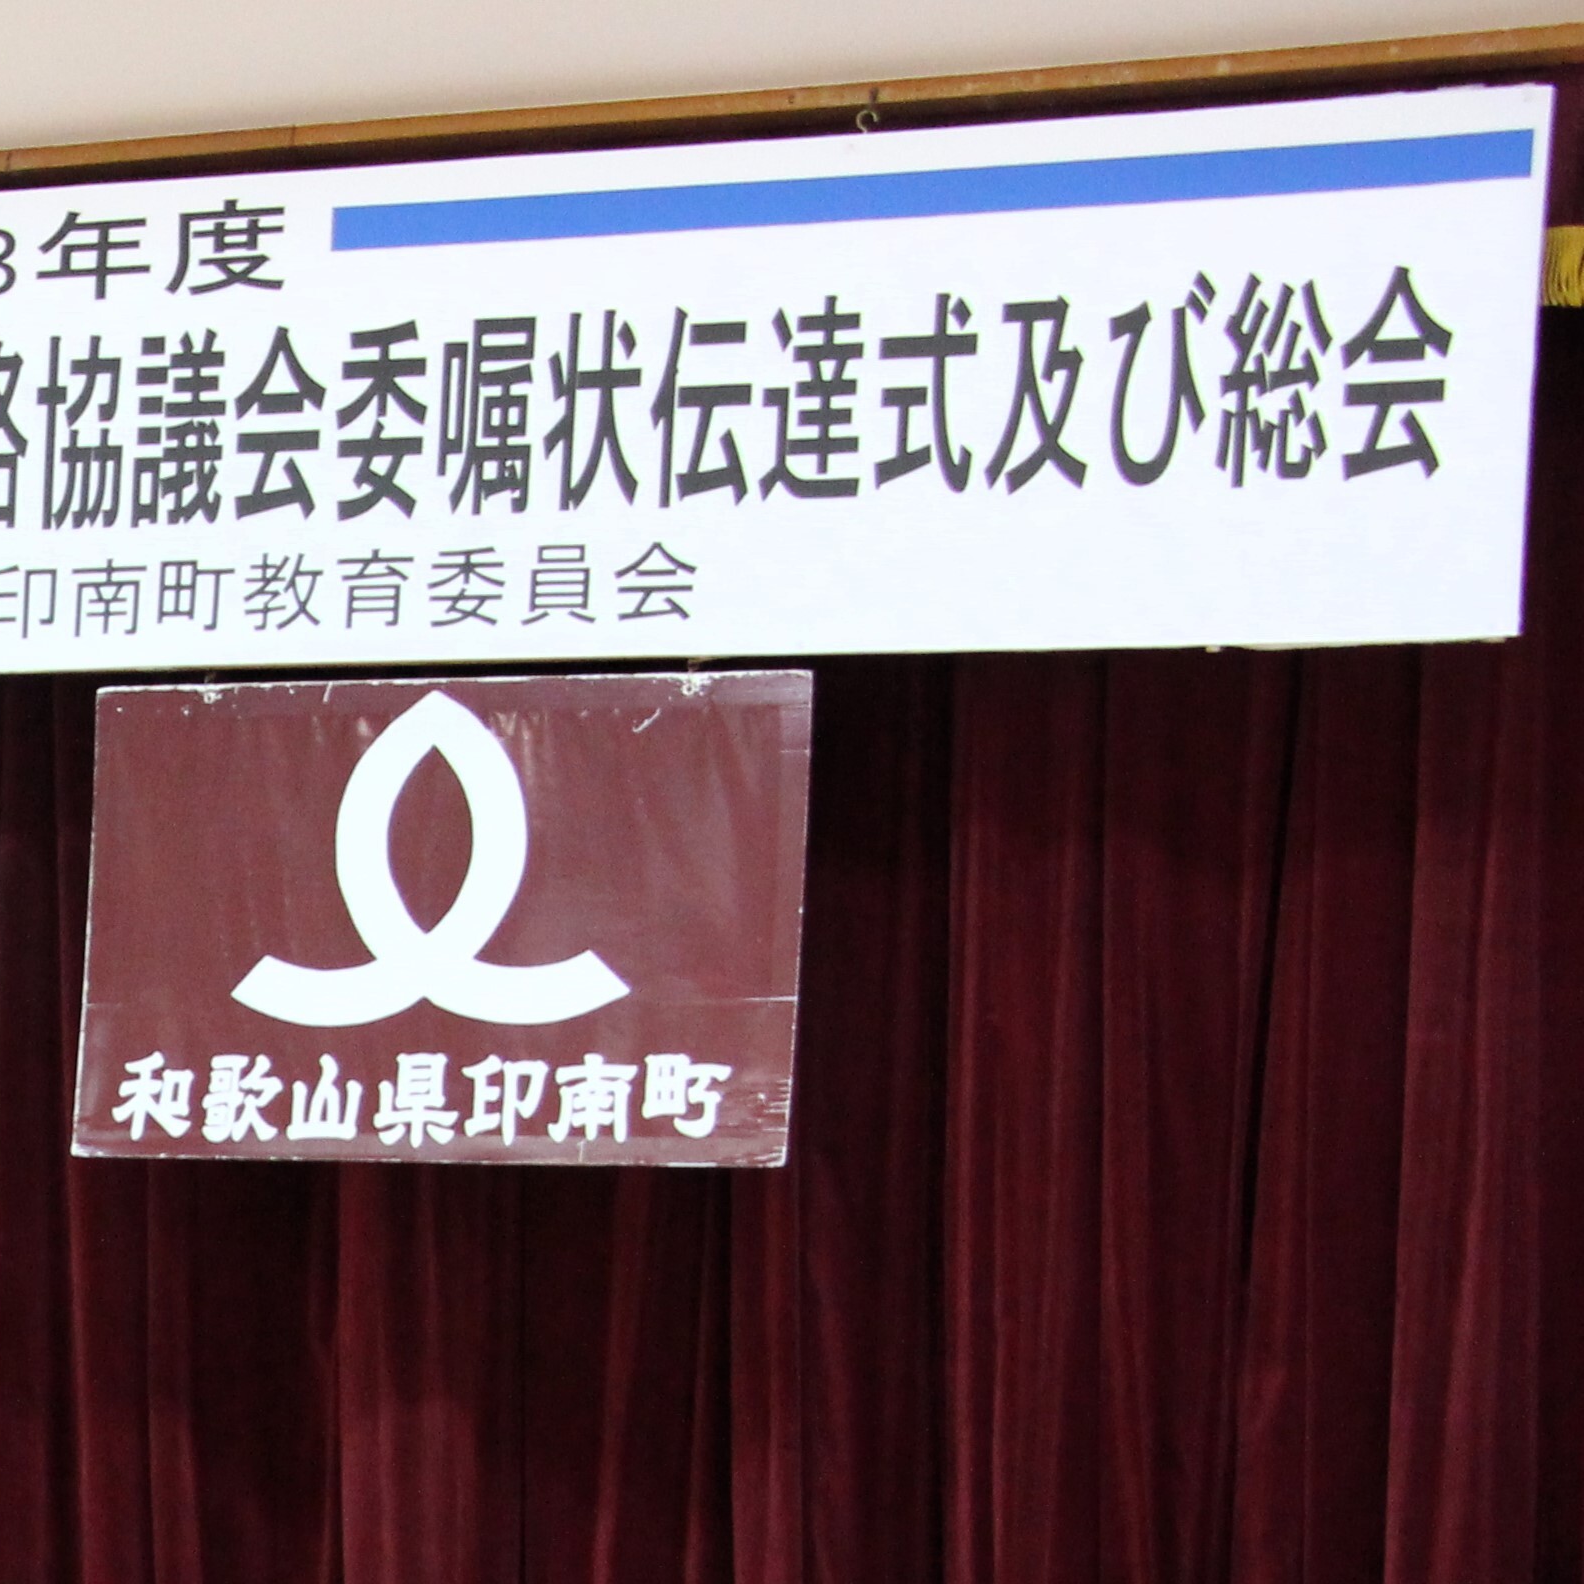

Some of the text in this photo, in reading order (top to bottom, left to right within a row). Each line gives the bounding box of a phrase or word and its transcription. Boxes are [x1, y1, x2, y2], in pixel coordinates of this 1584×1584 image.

[111, 1050, 732, 1147] 和歌山県印南町
